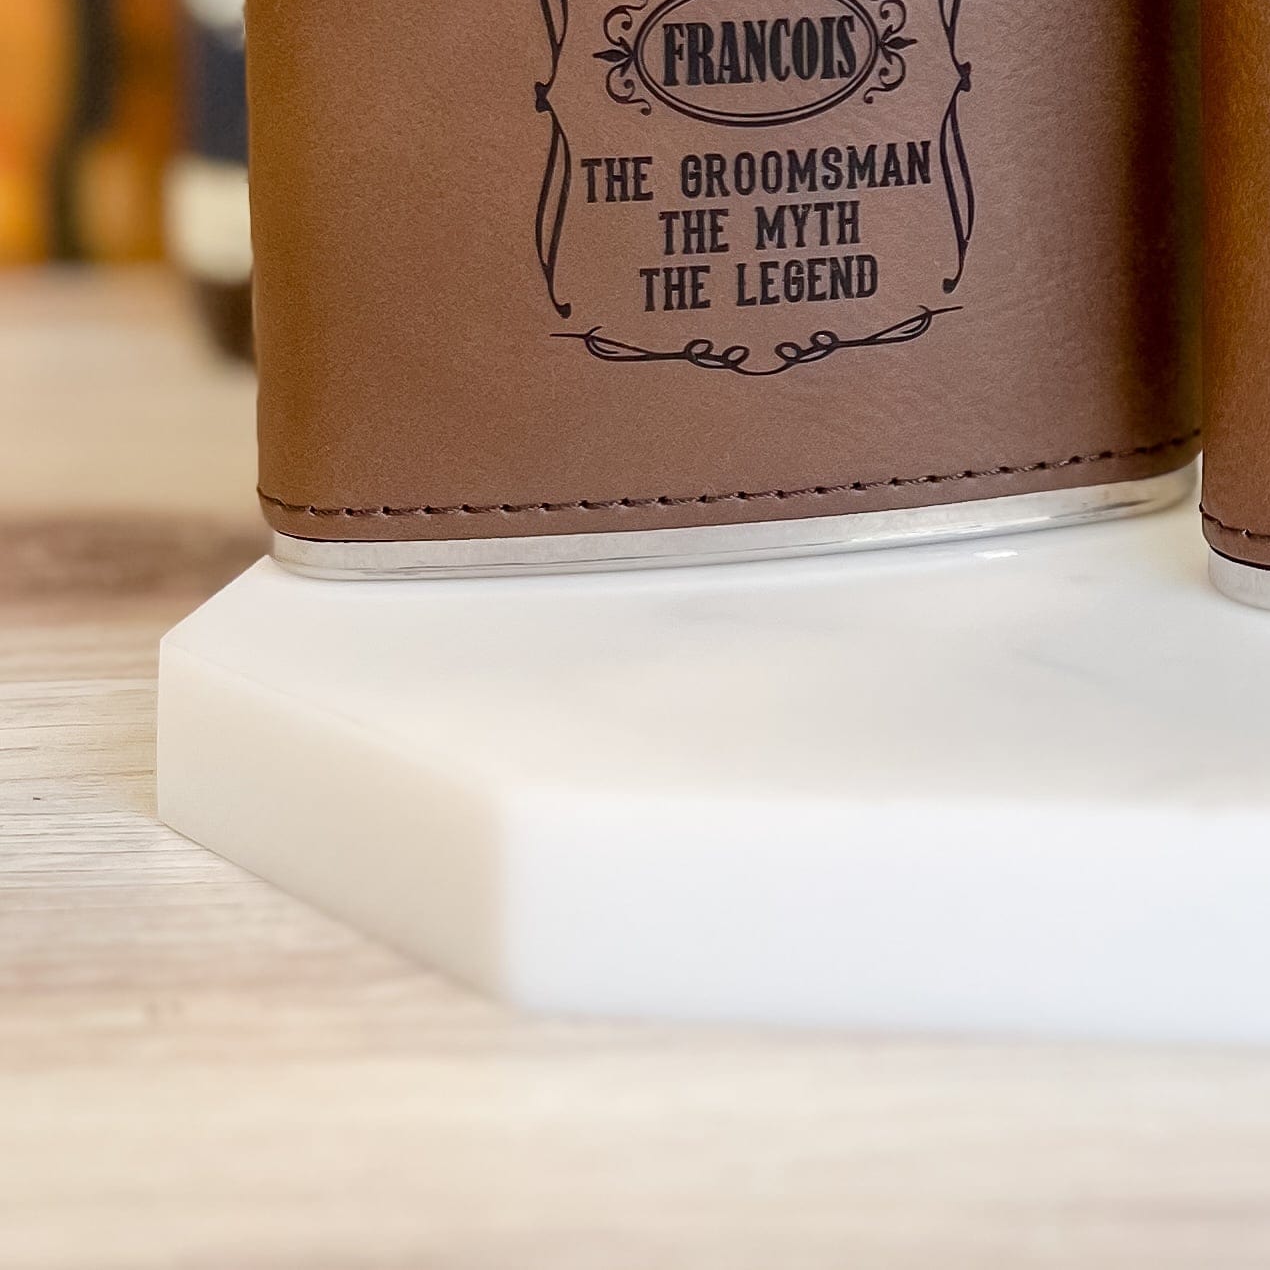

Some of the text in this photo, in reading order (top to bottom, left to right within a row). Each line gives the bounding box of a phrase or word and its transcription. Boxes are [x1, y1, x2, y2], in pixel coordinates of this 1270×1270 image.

[661, 16, 857, 87] FRANCOIS
[580, 140, 932, 204] THE GROOMSMAN
[658, 200, 861, 256] THE MYTH
[638, 254, 879, 312] THE LEGEND
